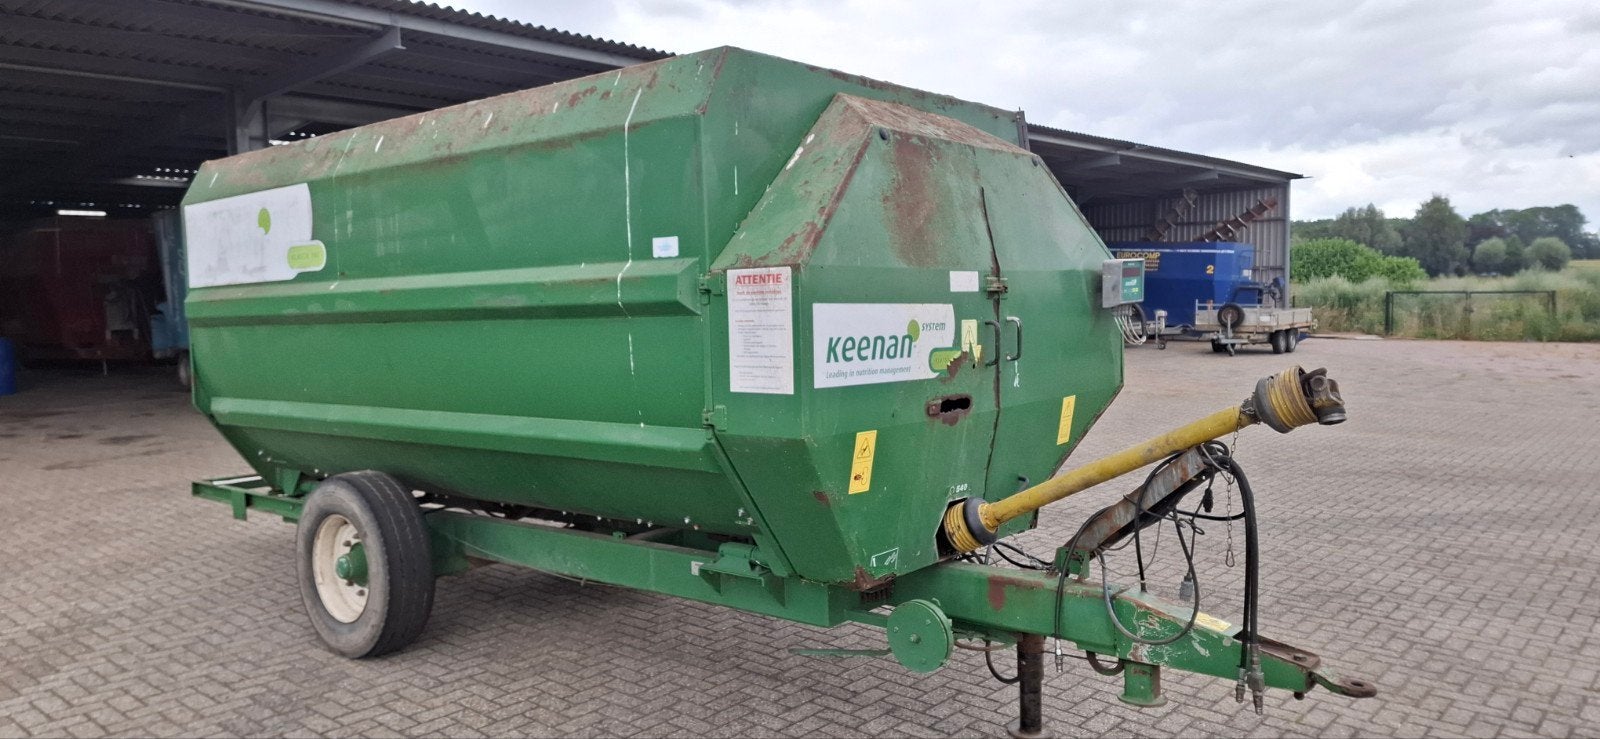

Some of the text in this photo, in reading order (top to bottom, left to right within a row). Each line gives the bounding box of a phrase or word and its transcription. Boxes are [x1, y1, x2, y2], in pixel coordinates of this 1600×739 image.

[1206, 264, 1215, 274] 2
[736, 273, 783, 285] ATTENTIE
[826, 369, 848, 380] Leading
[855, 367, 879, 377] nutrition
[879, 366, 912, 376] management
